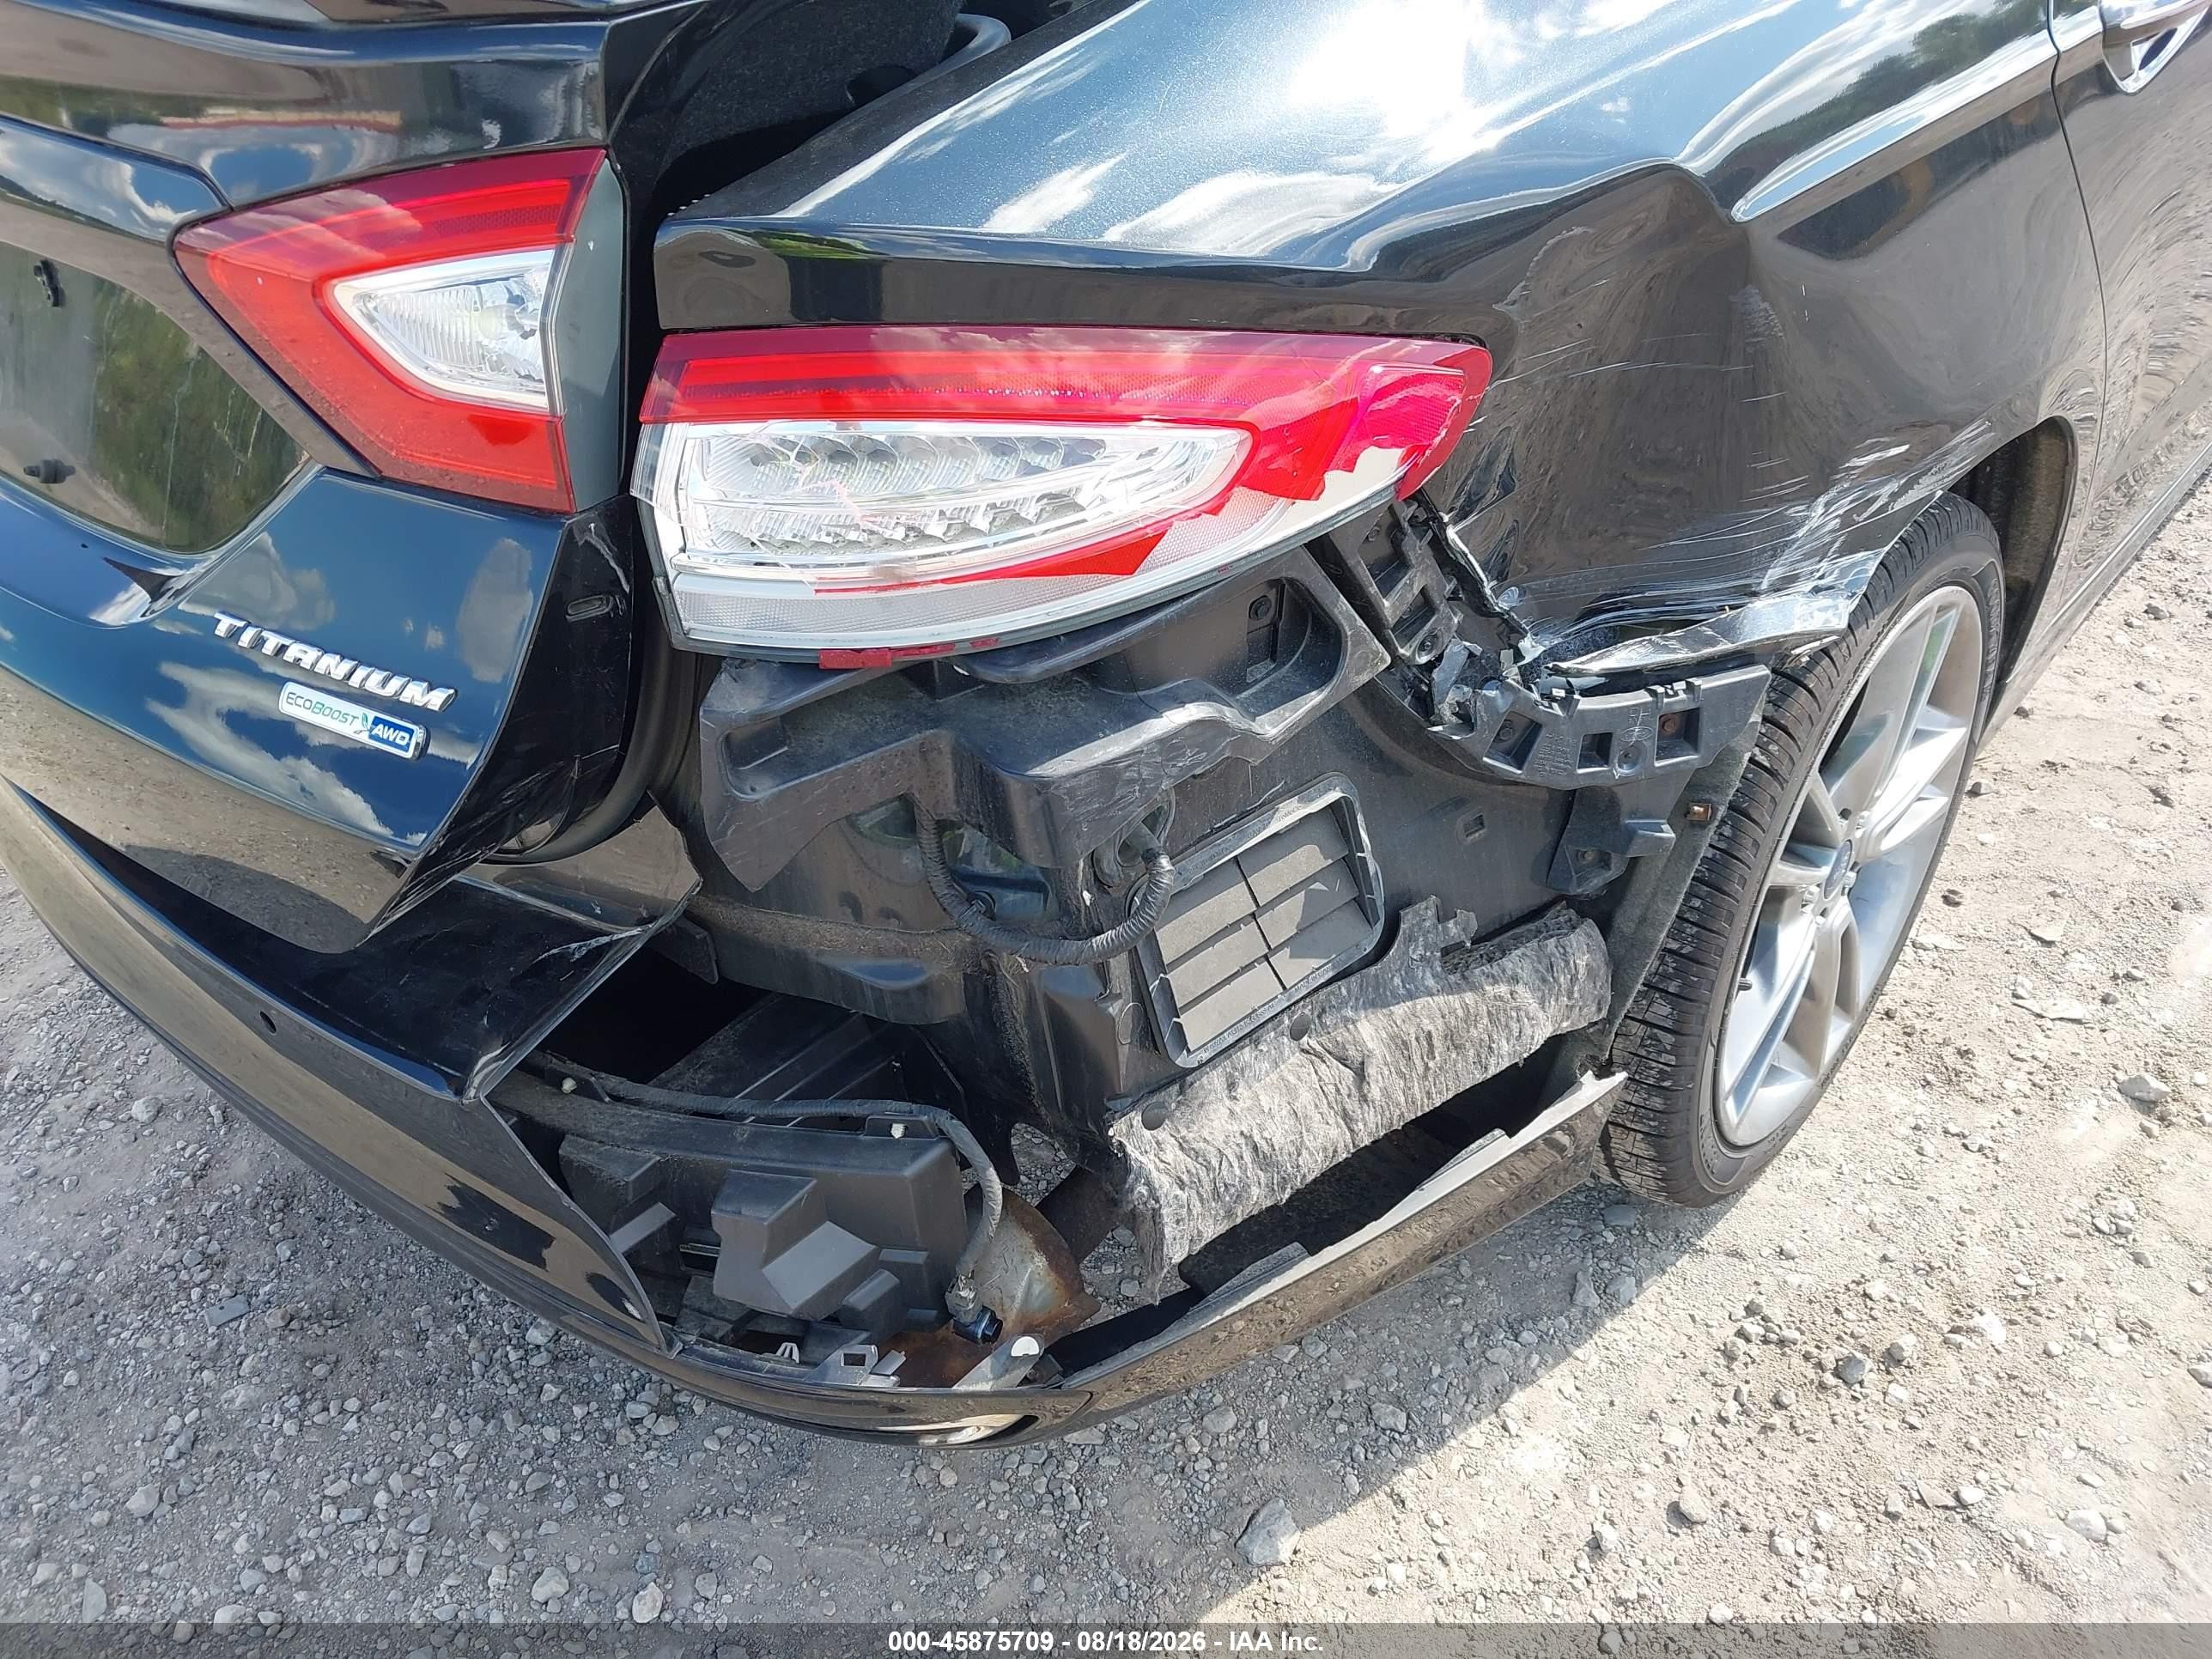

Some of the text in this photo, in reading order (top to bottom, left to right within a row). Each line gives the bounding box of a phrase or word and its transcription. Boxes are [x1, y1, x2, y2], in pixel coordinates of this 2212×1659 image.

[214, 611, 457, 712] TITANIUM
[285, 691, 411, 746] ECOBOOST AWD
